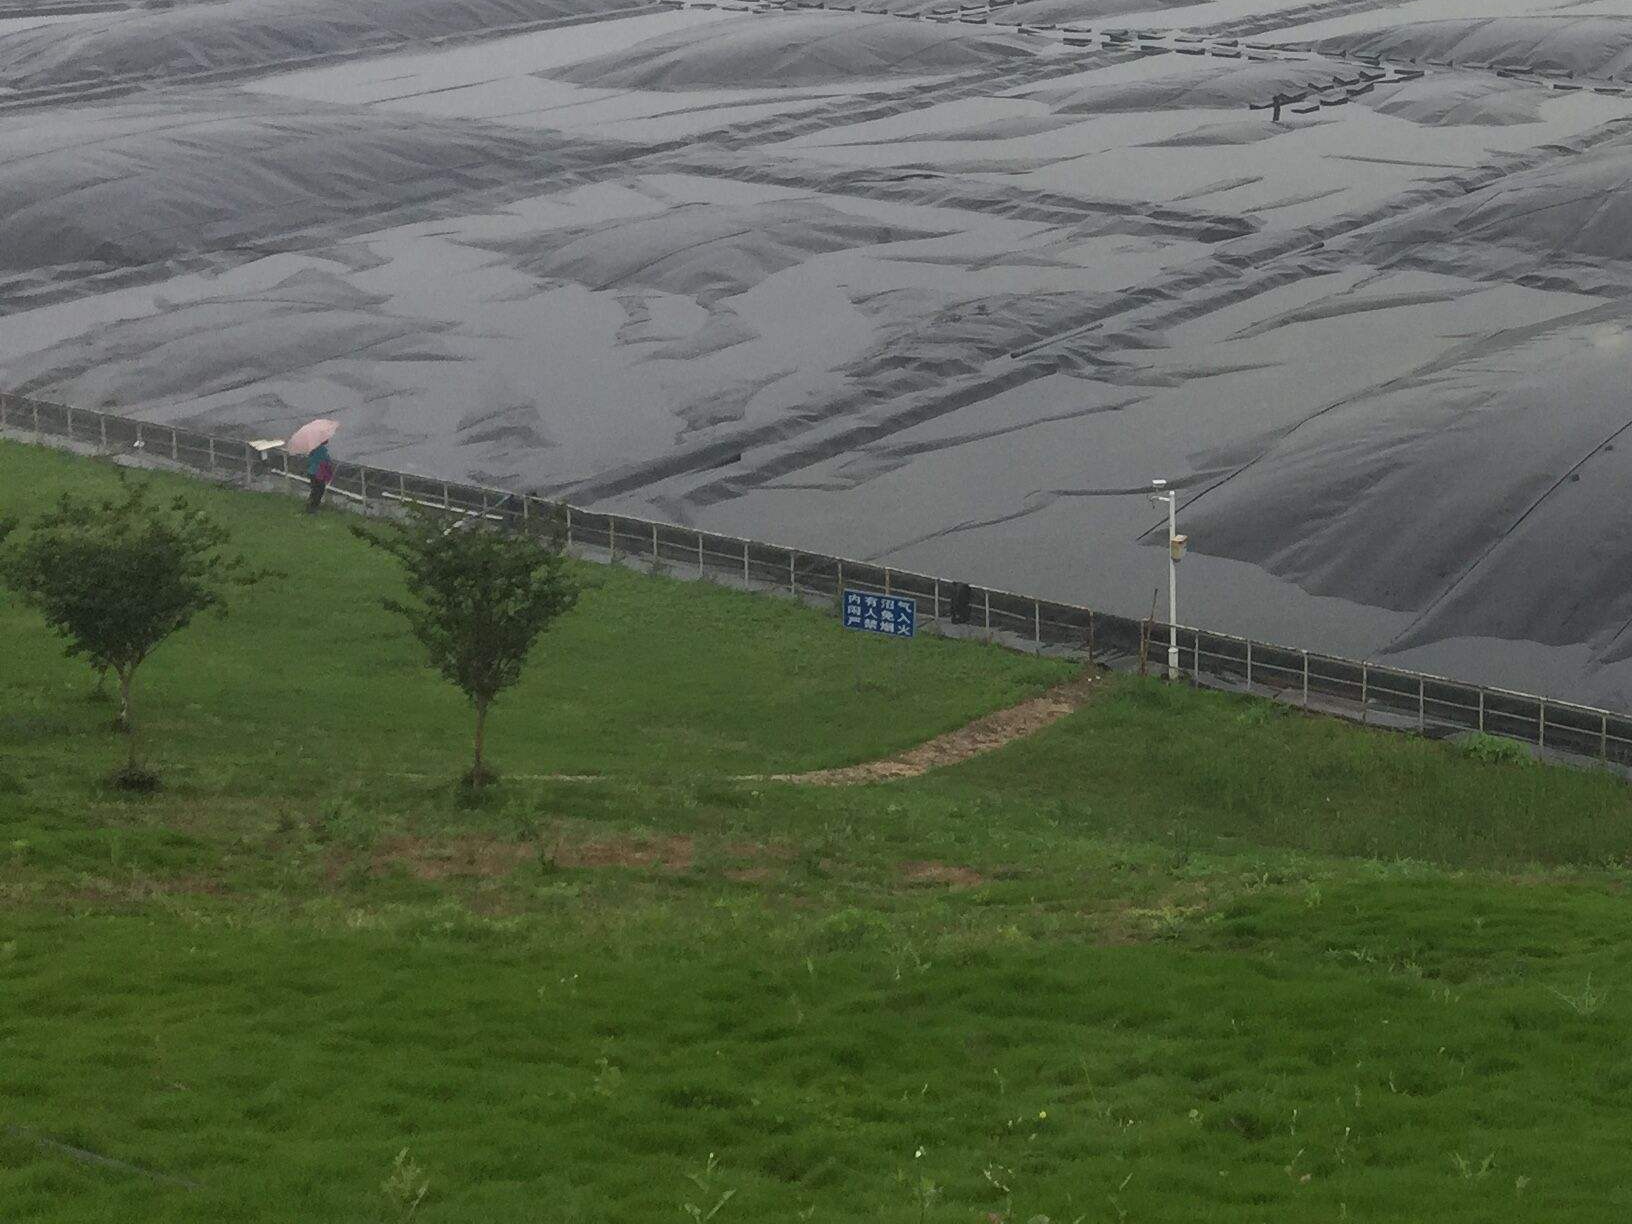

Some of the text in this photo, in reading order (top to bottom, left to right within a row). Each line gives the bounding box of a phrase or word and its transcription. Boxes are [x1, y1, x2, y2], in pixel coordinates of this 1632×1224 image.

[848, 594, 912, 613] 内有沼气
[847, 616, 911, 635] 严禁烟火
